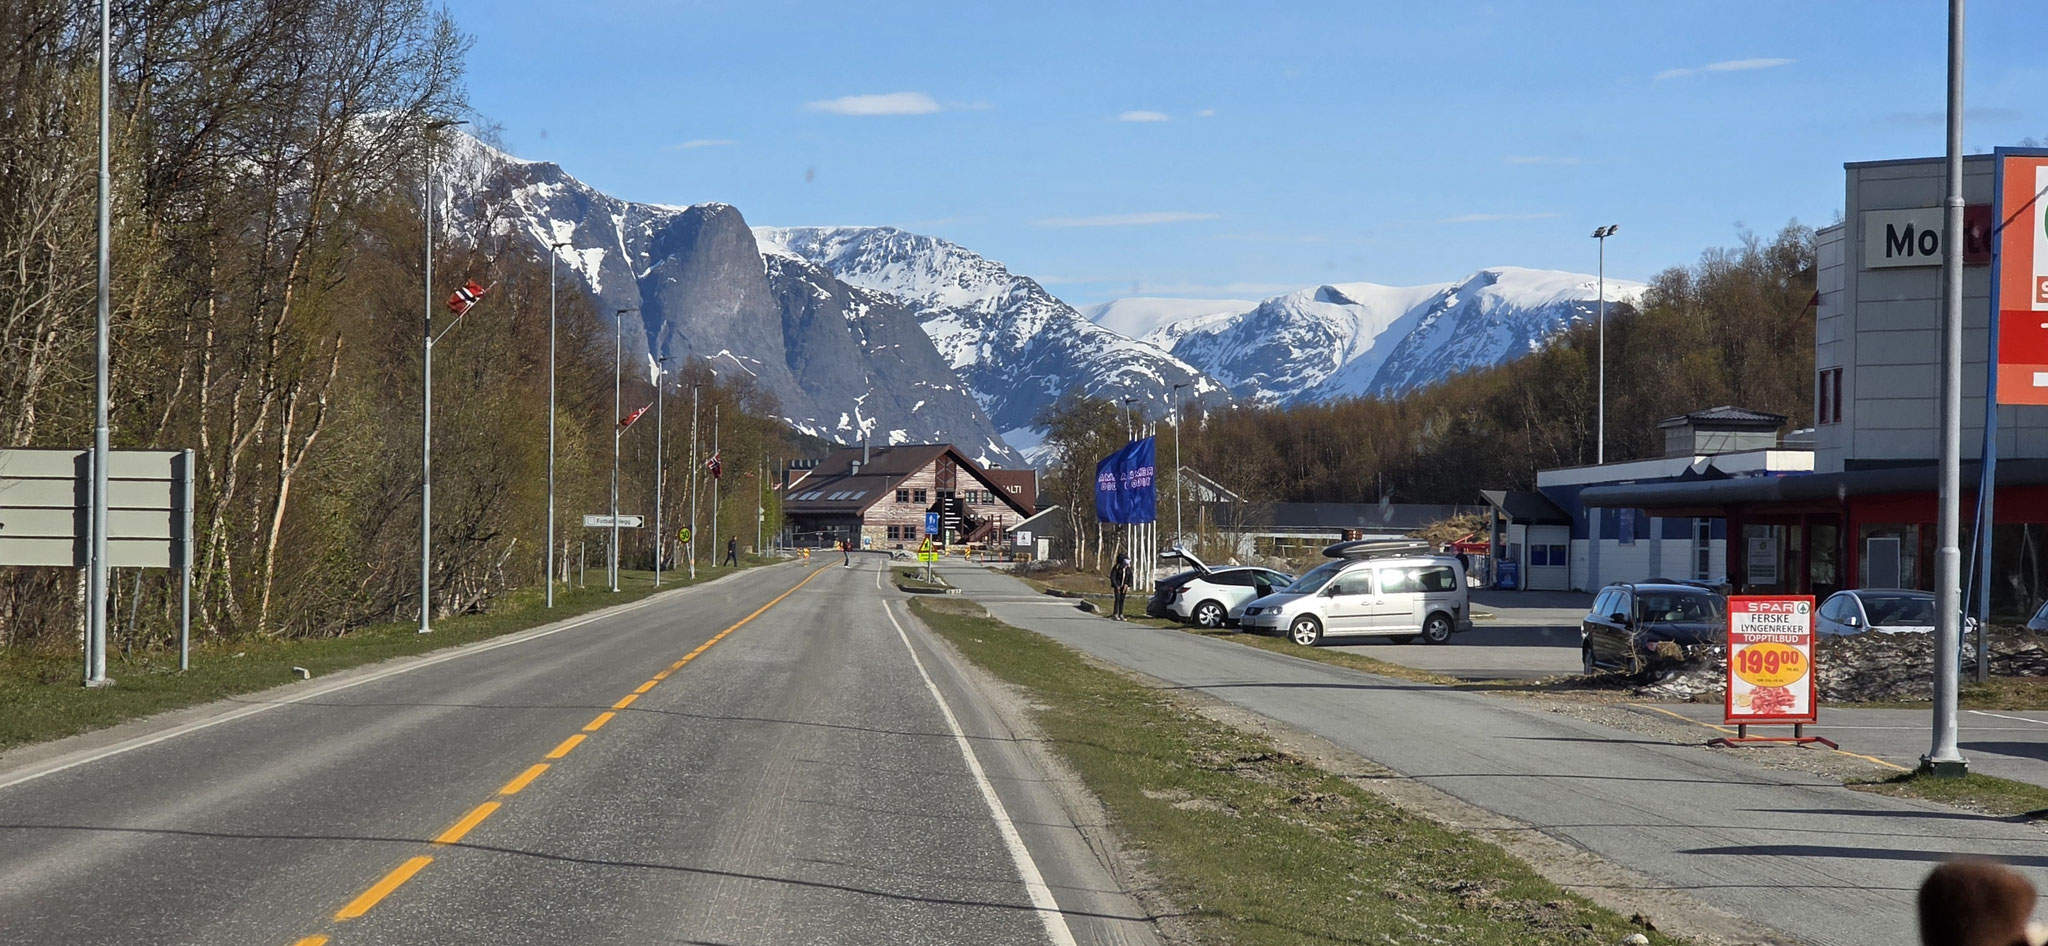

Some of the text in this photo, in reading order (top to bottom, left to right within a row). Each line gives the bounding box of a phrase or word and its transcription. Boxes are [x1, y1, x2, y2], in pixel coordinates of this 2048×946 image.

[1003, 485, 1022, 493] ALTI
[681, 531, 690, 539] 30
[1748, 603, 1793, 612] SPAR
[1751, 614, 1789, 623] FERSKE
[1741, 624, 1804, 633] LYNGENREKER
[1744, 634, 1799, 643] TOPPTILBUD
